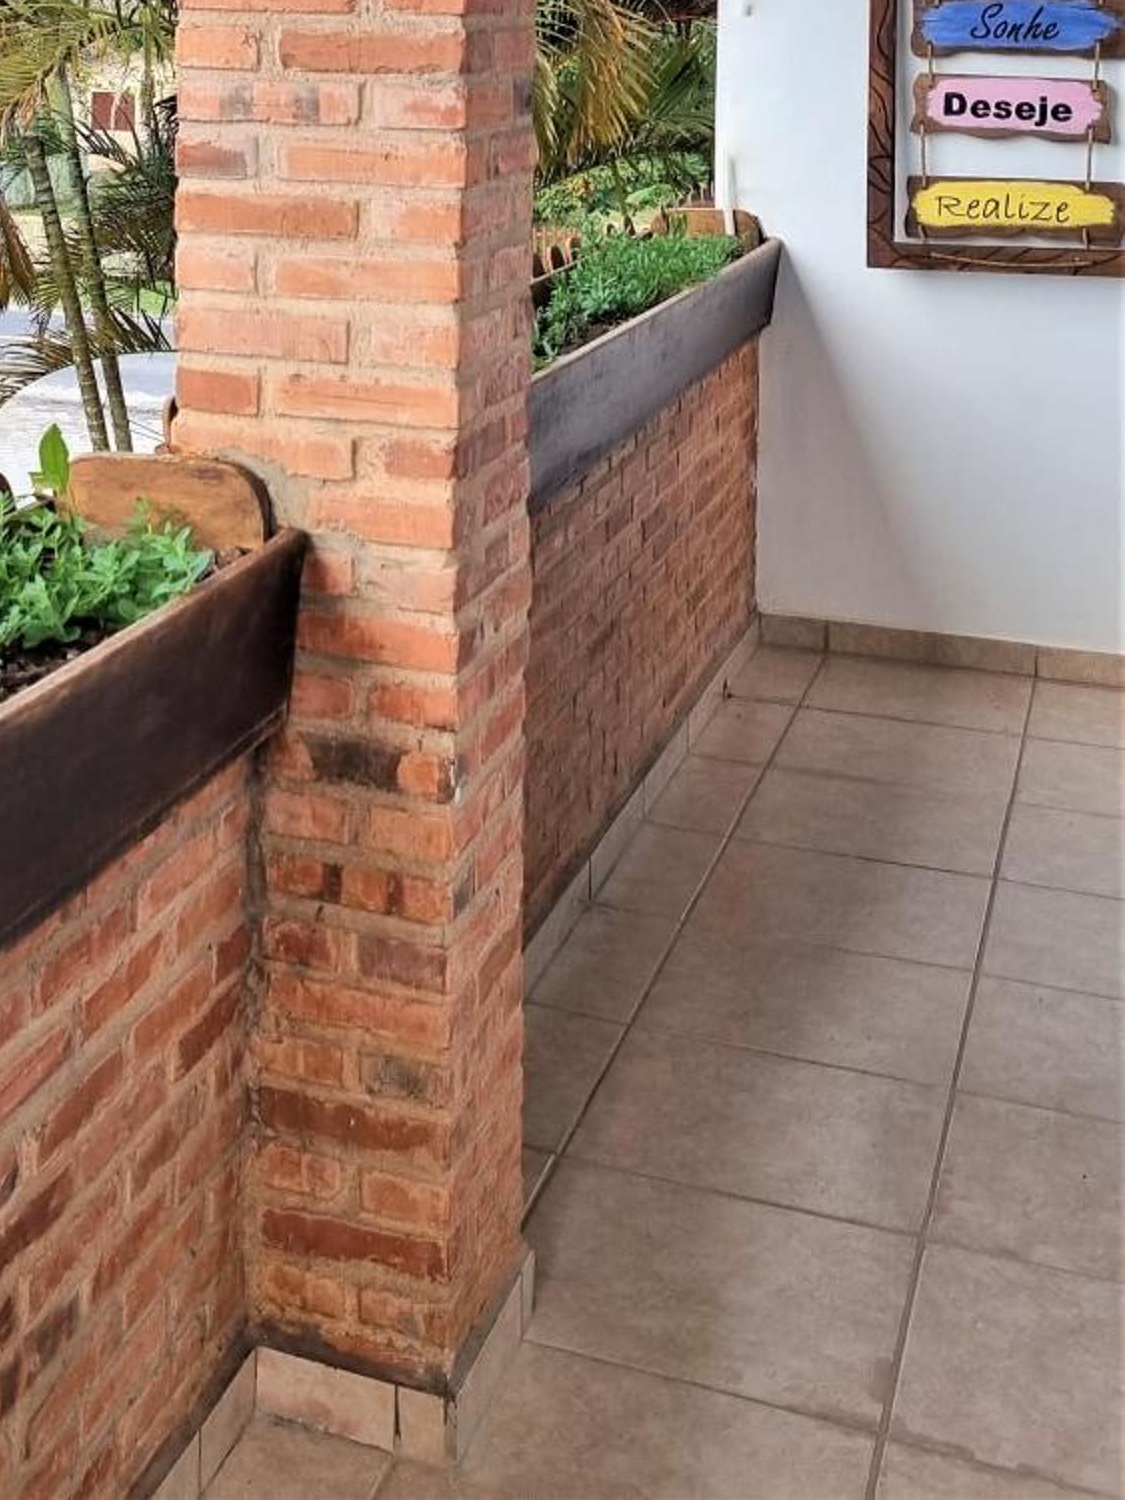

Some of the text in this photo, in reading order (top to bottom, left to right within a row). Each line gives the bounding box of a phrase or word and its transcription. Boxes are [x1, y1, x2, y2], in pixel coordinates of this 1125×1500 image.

[970, 2, 1060, 43] Sonhe
[943, 91, 1073, 127] Deseje
[934, 193, 1070, 224] Realize
